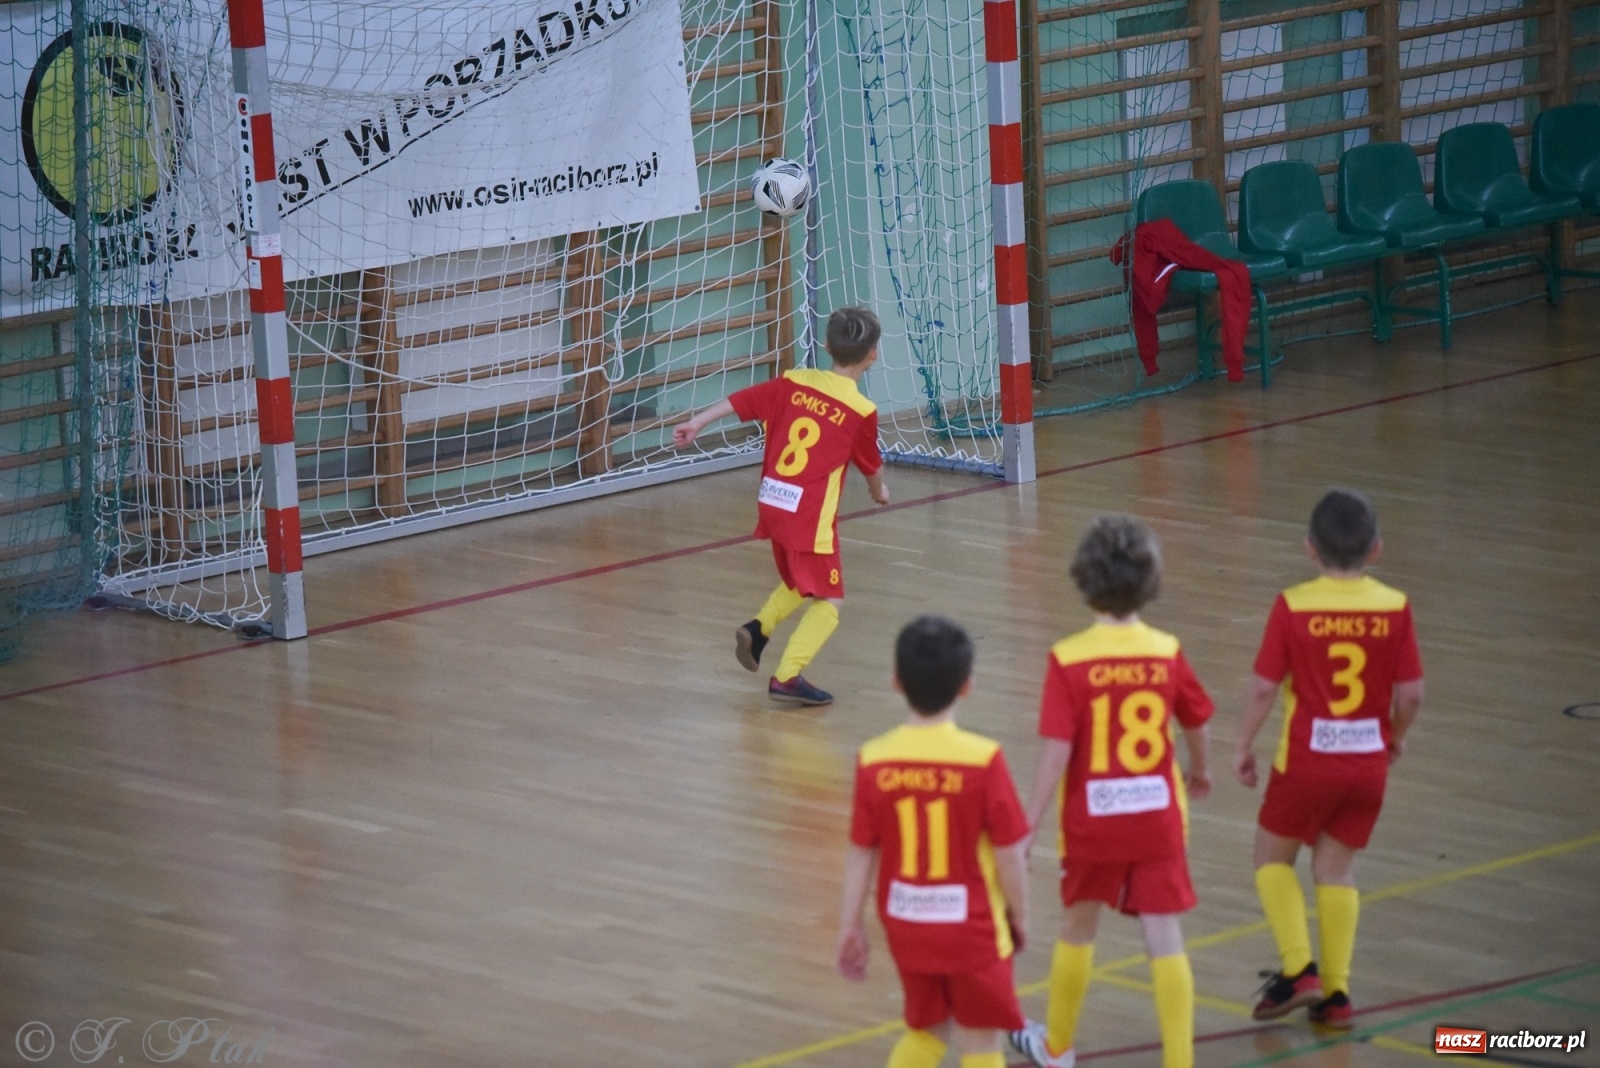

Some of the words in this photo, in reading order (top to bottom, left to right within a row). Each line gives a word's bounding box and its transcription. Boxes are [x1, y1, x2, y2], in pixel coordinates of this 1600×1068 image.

[343, 109, 391, 166] W
[244, 164, 254, 229] sport
[408, 152, 659, 218] www.osir-raciborz.pl
[790, 391, 830, 416] GMKS
[828, 407, 847, 427] 21
[775, 416, 821, 478] 8
[829, 568, 840, 585] 8
[1308, 616, 1366, 638] GMKS
[1370, 616, 1390, 638] 21
[1088, 663, 1147, 688] GMKS
[1149, 663, 1169, 686] 21
[1328, 642, 1367, 717] 3
[1089, 690, 1167, 774] 18
[876, 767, 938, 793] GMKS
[939, 768, 965, 794] 21
[895, 795, 949, 880] 11
